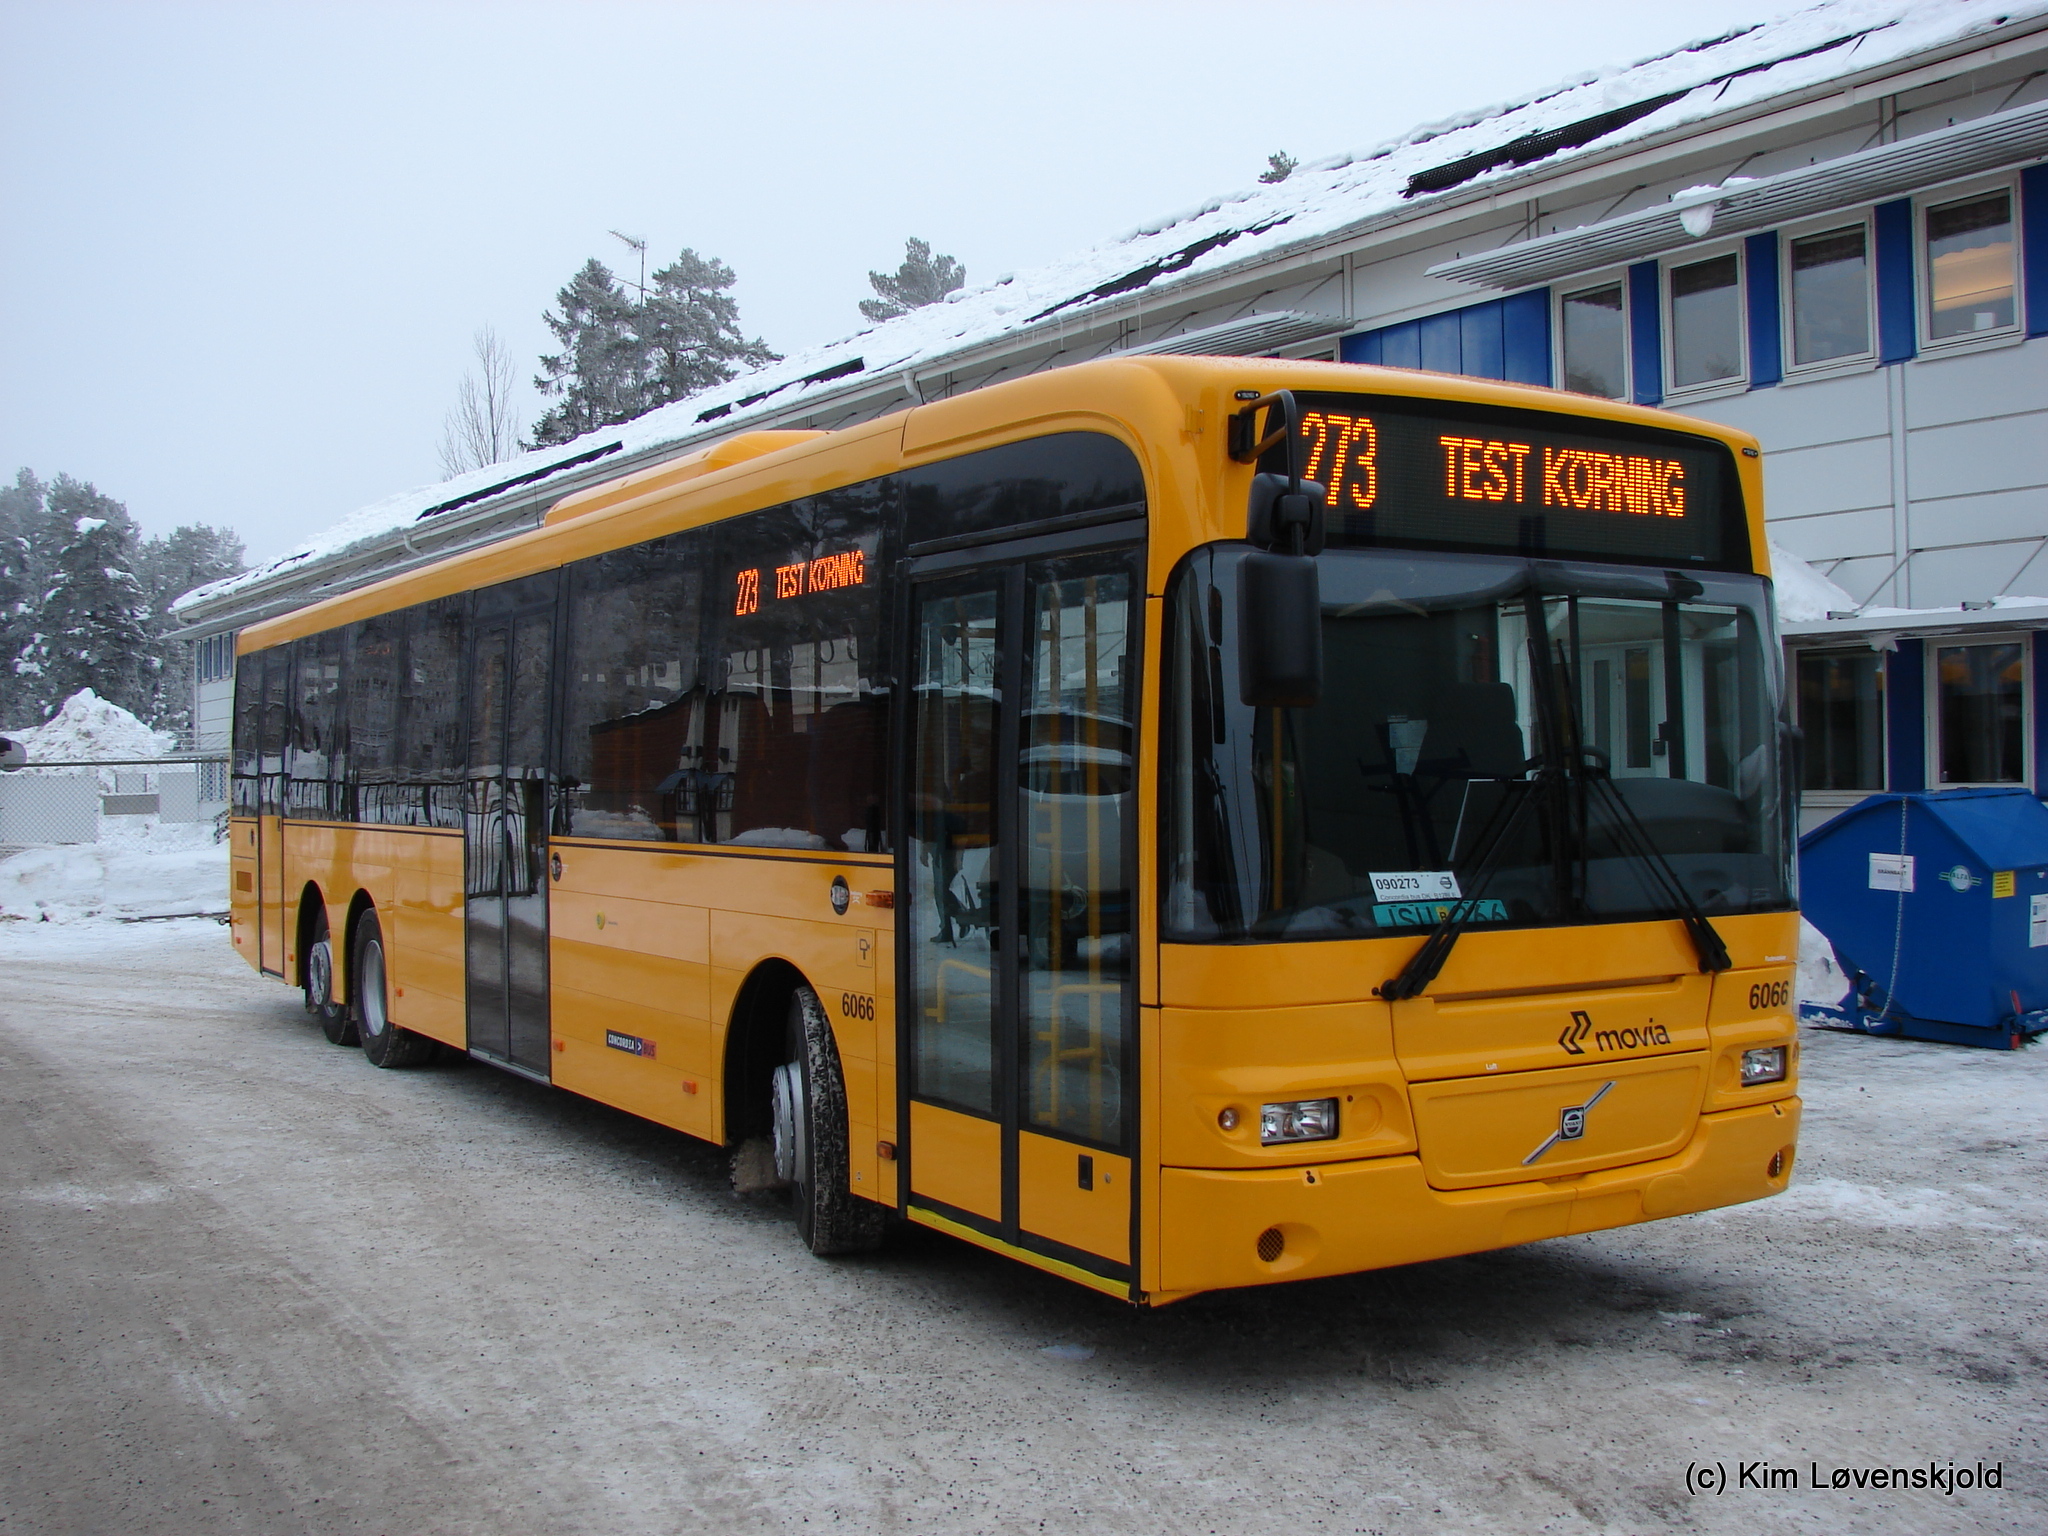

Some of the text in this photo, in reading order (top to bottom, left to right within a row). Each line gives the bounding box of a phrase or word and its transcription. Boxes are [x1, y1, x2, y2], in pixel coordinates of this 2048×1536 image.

[1302, 411, 1377, 509] 273
[1440, 435, 1531, 504] TEST
[735, 568, 760, 616] 273
[775, 562, 807, 600] TEST
[1375, 878, 1420, 890] 090273
[842, 992, 875, 1021] 6066
[1749, 980, 1789, 1010] 6066
[1595, 1017, 1671, 1052] movia
